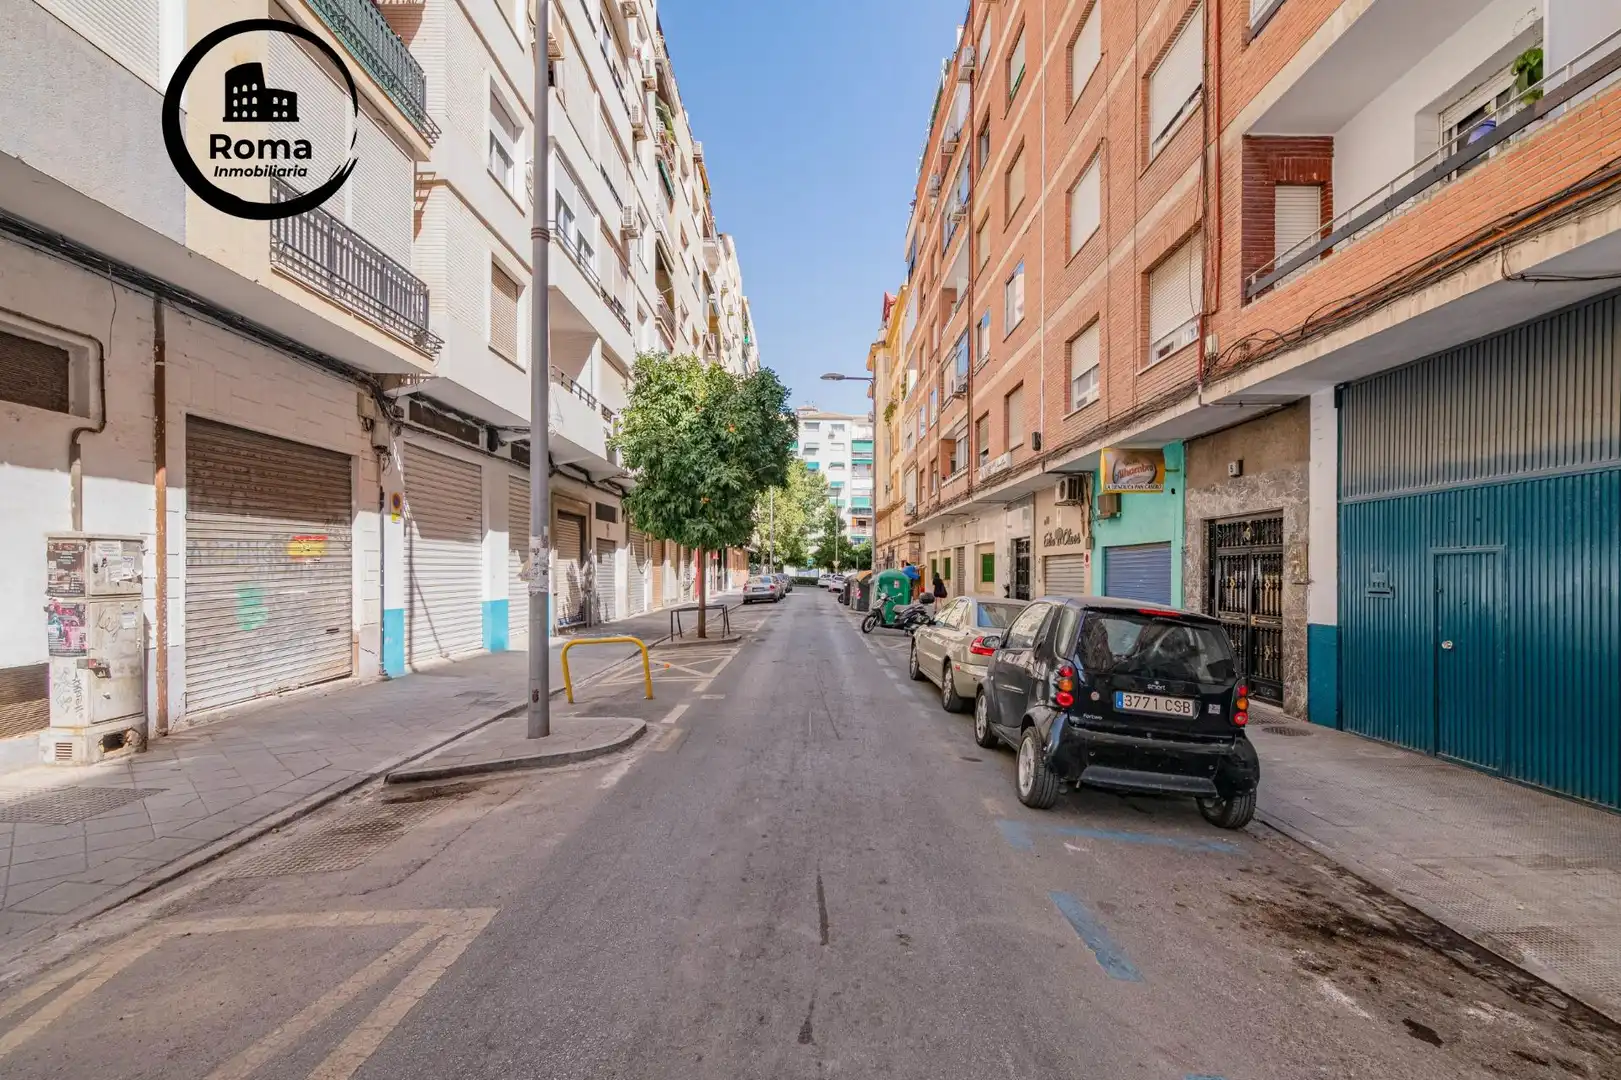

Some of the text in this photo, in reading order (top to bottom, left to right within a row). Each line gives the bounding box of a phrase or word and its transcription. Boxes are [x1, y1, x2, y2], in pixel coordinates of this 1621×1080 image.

[1147, 683, 1166, 691] smart
[1124, 694, 1158, 711] 3771
[1164, 699, 1191, 714] CSB
